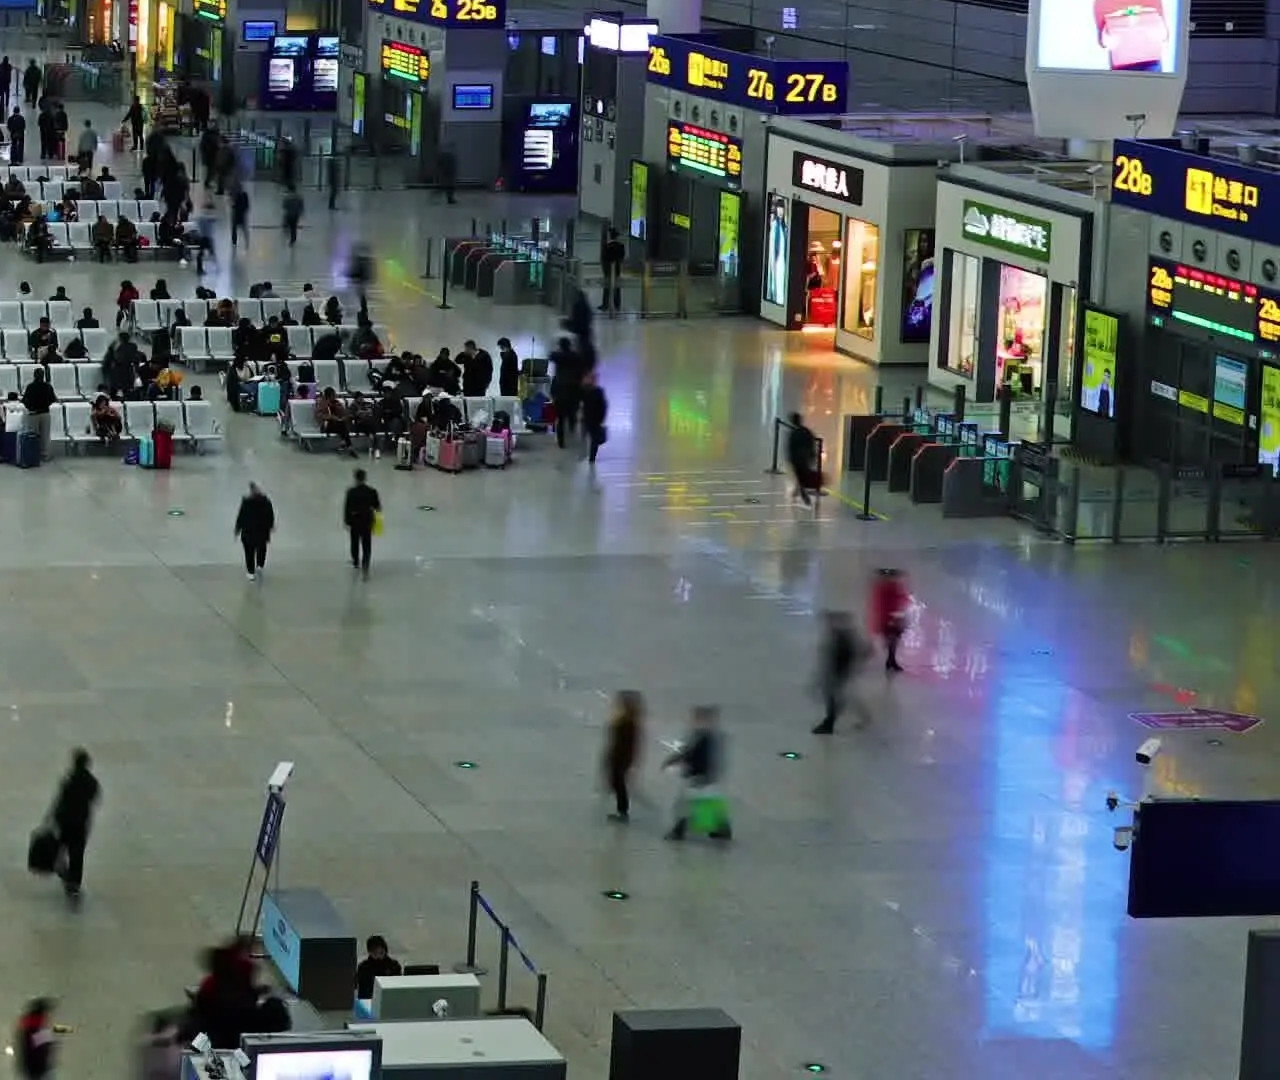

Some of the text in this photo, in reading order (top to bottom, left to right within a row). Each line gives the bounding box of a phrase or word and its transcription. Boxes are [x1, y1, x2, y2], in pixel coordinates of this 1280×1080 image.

[648, 46, 671, 75] 26B
[747, 69, 774, 101] 27B
[785, 73, 837, 102] 27B
[1114, 155, 1258, 207] 28B 检票口
